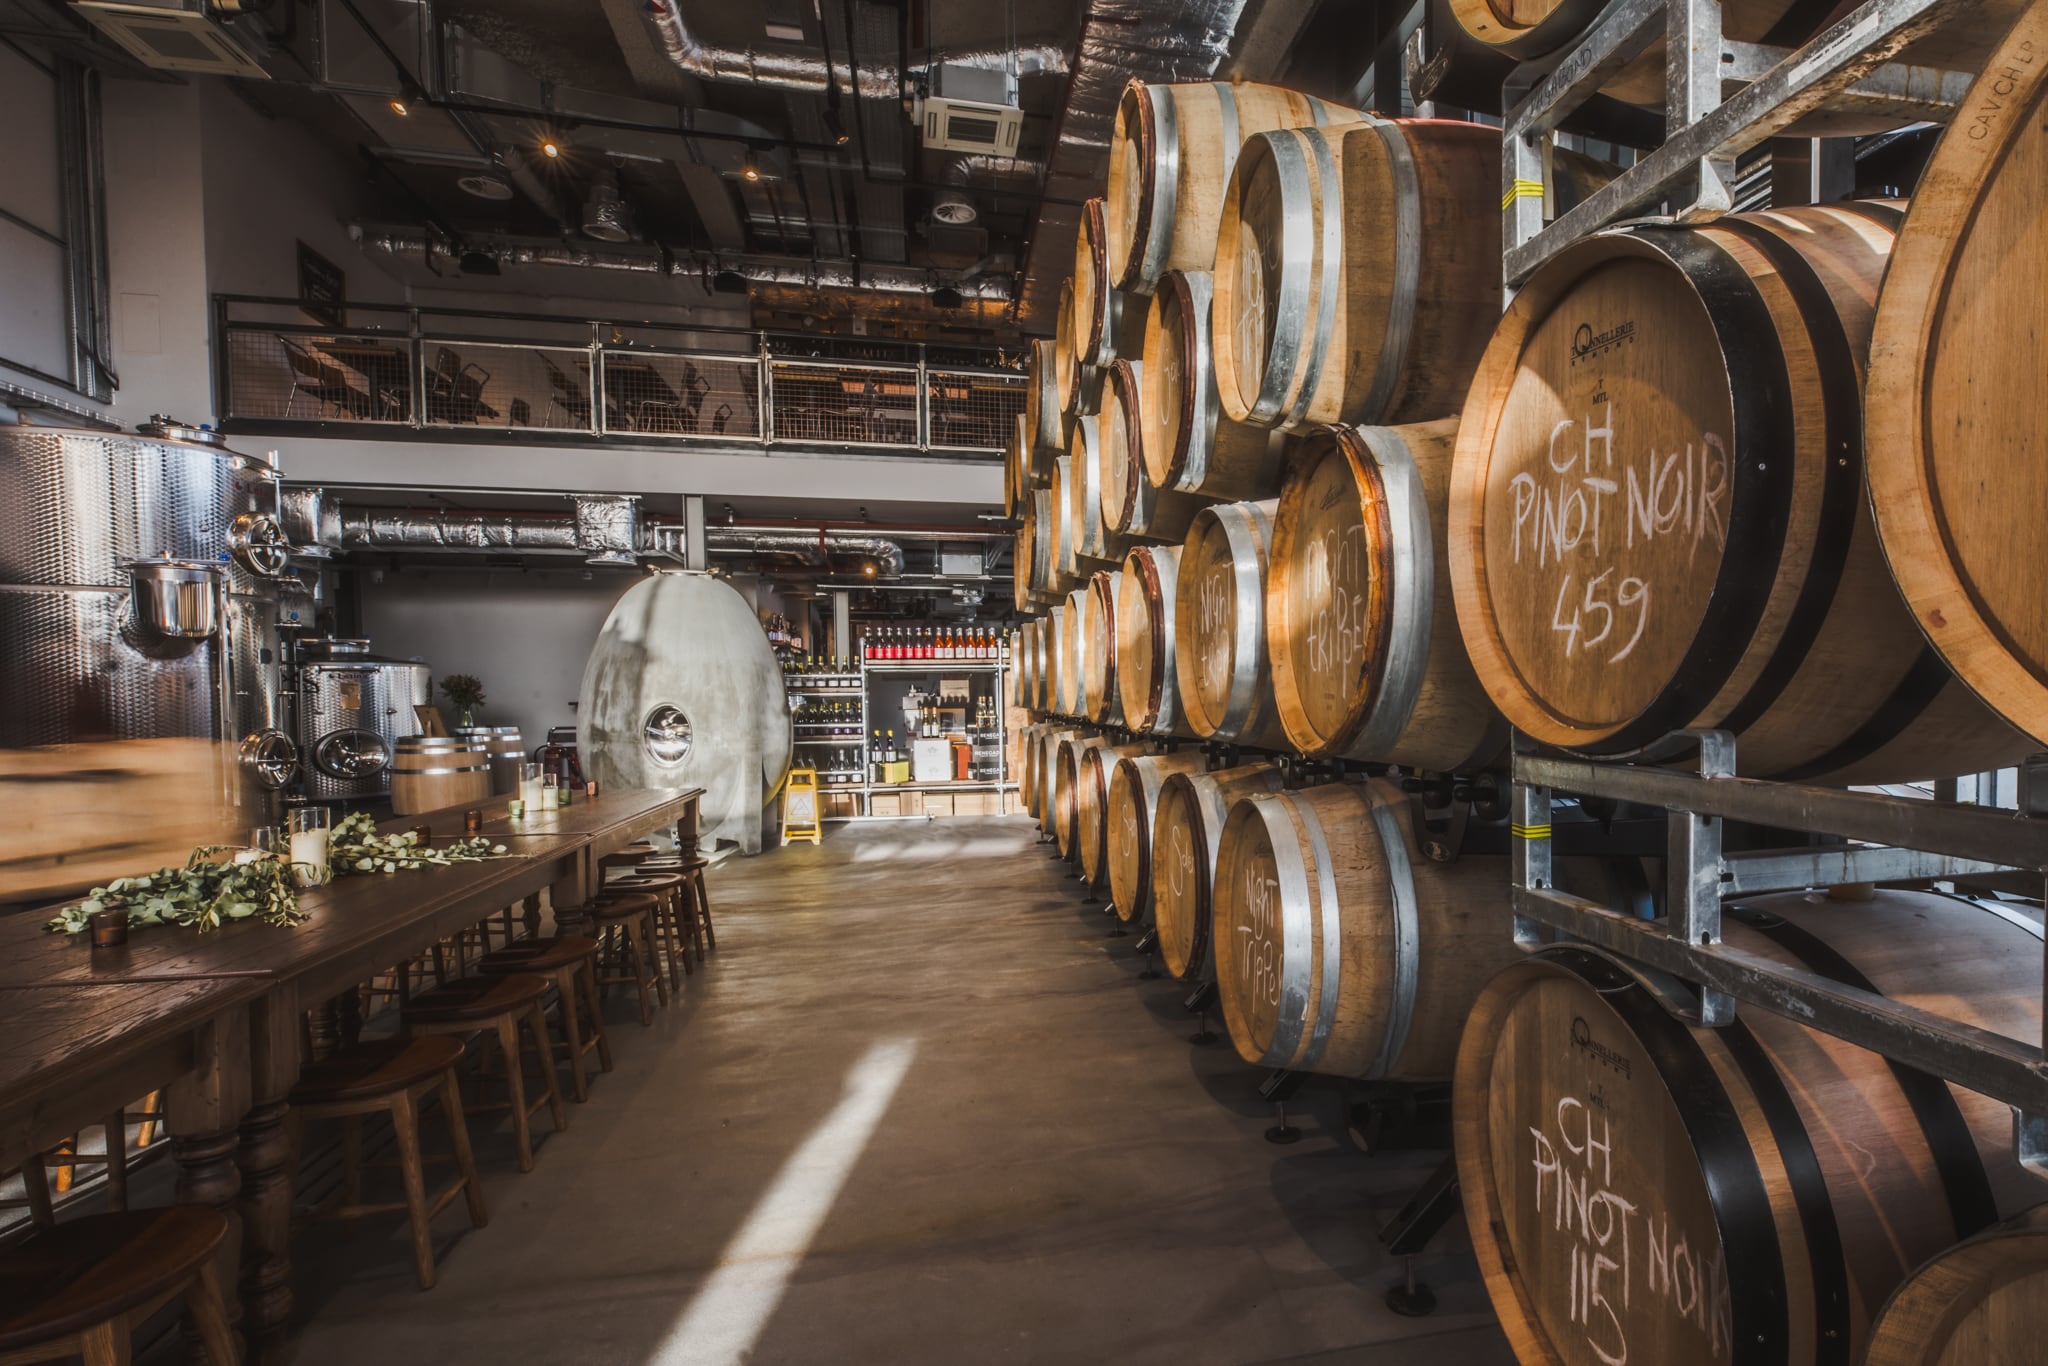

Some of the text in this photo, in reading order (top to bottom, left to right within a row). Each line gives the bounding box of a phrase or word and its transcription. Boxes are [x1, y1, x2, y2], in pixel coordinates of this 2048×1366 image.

[1550, 401, 1614, 474] CH
[1507, 432, 1728, 570] PINOT NOIR
[1551, 566, 1649, 664] 459
[1557, 1096, 1612, 1188] CH
[1528, 1125, 1638, 1312] PINOT
[1570, 1242, 1627, 1366] 115
